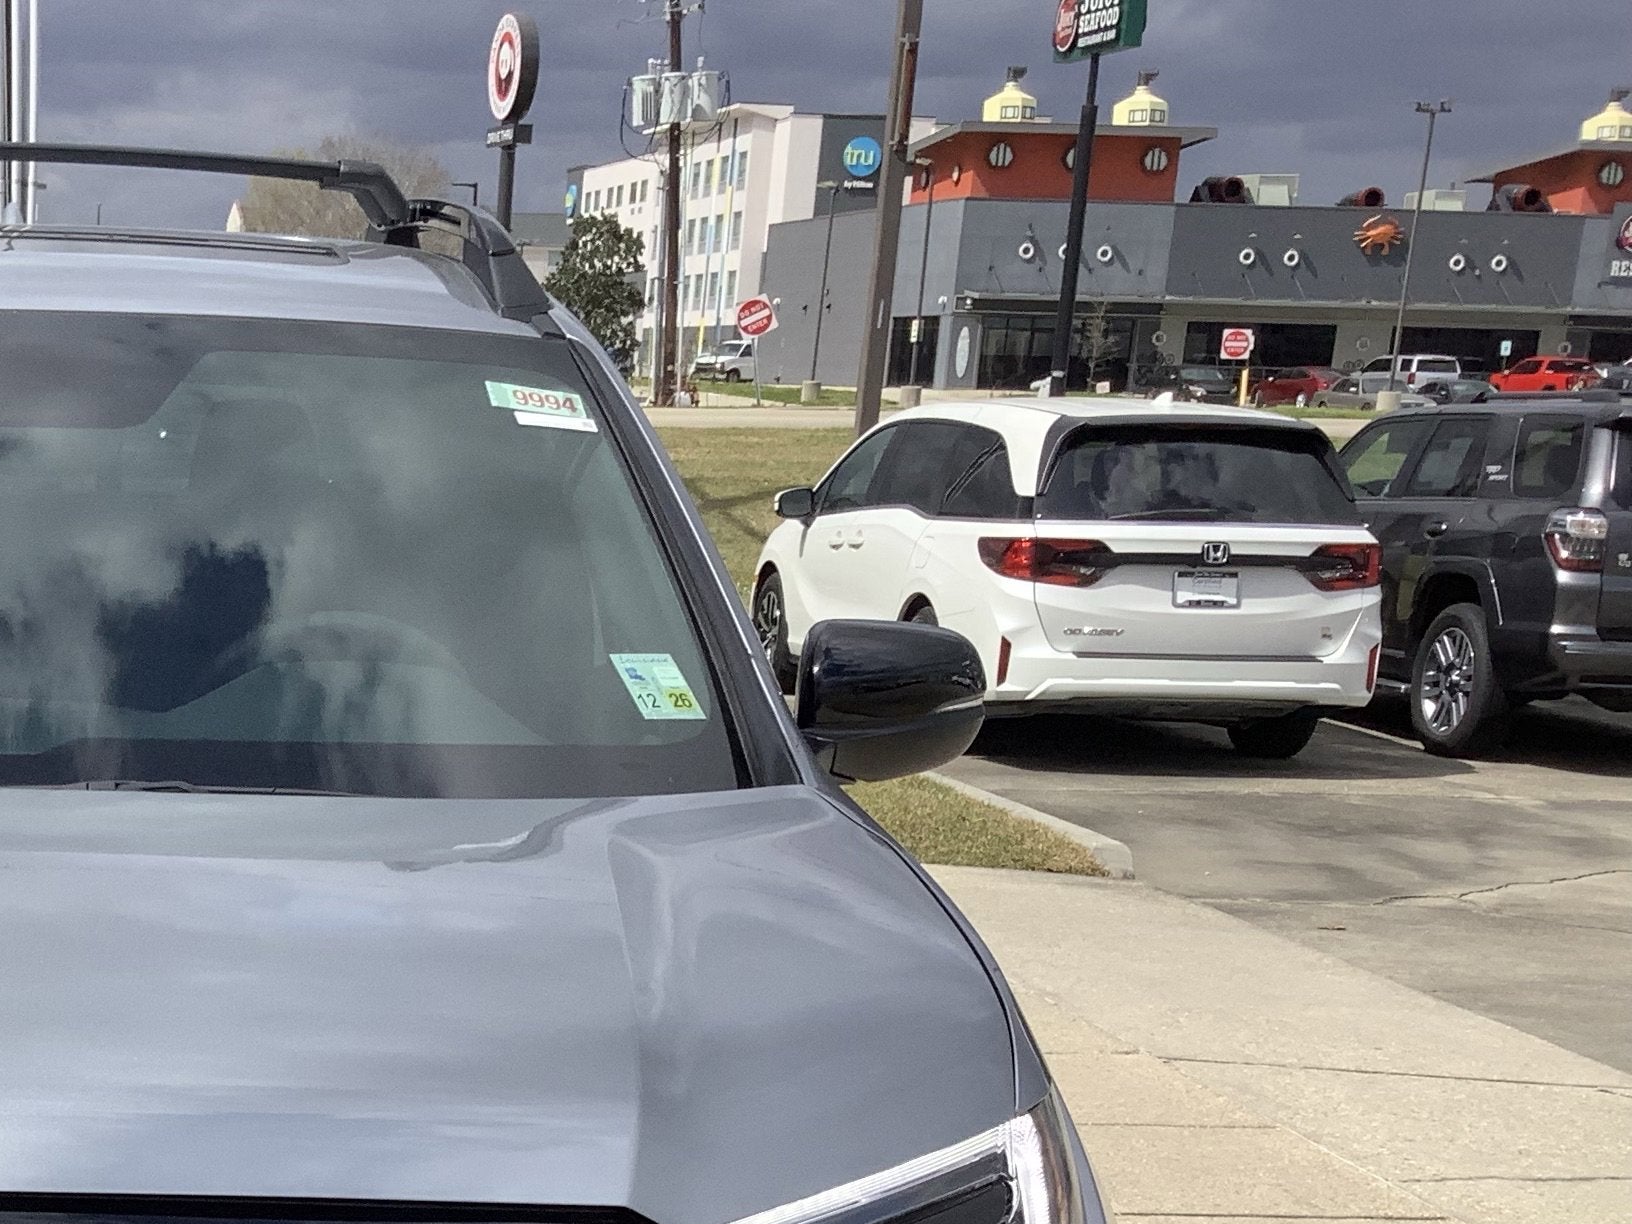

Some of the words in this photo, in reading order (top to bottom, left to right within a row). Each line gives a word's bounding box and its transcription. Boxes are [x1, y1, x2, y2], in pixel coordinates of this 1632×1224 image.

[1078, 6, 1120, 34] SEAFOOD
[843, 143, 875, 166] tru
[512, 389, 579, 414] 9994
[637, 693, 662, 709] 12
[668, 692, 693, 709] 26
